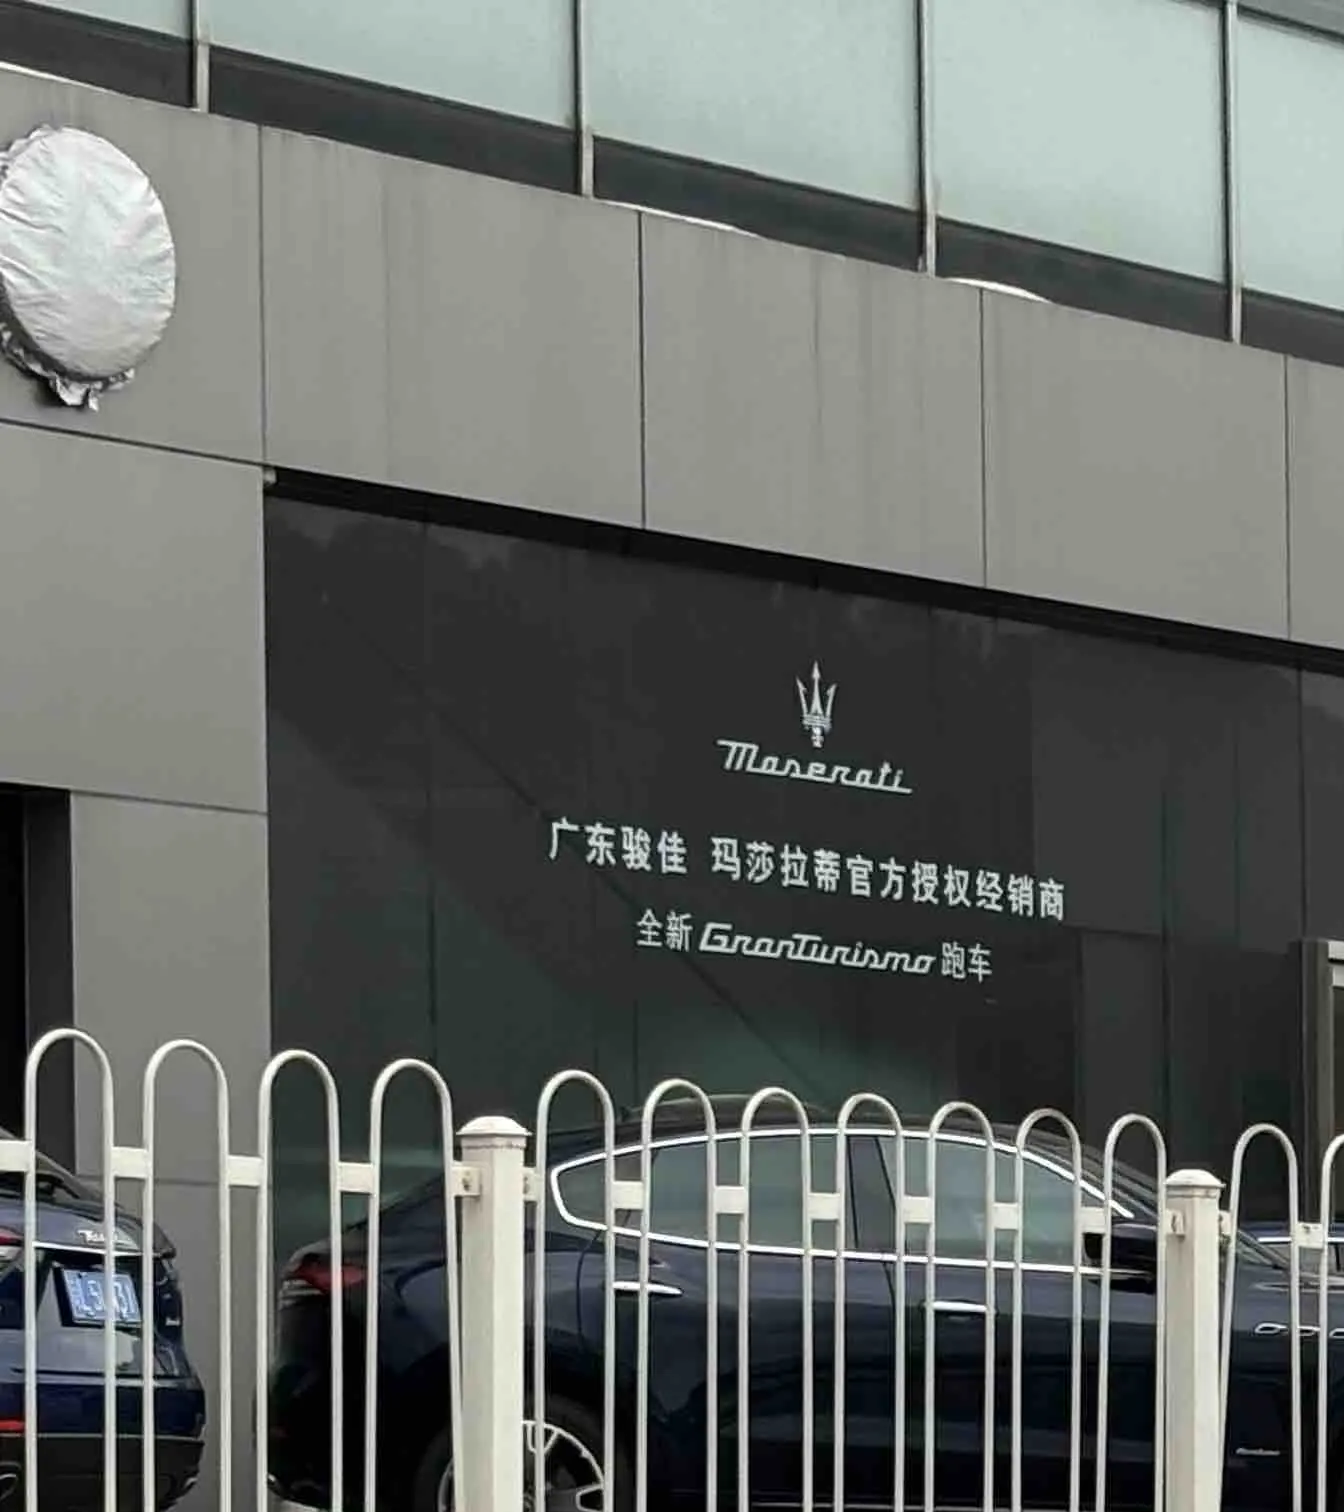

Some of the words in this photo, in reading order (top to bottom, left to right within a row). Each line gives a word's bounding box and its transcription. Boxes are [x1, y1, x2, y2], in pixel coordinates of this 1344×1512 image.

[717, 738, 912, 794] Maserati
[549, 817, 688, 875] 广东骏佳
[710, 836, 1065, 922] 玛莎拉蒂官方授权经销商
[636, 908, 693, 952] 全新
[699, 922, 935, 974] GranTurismo
[941, 941, 993, 982] 跑车
